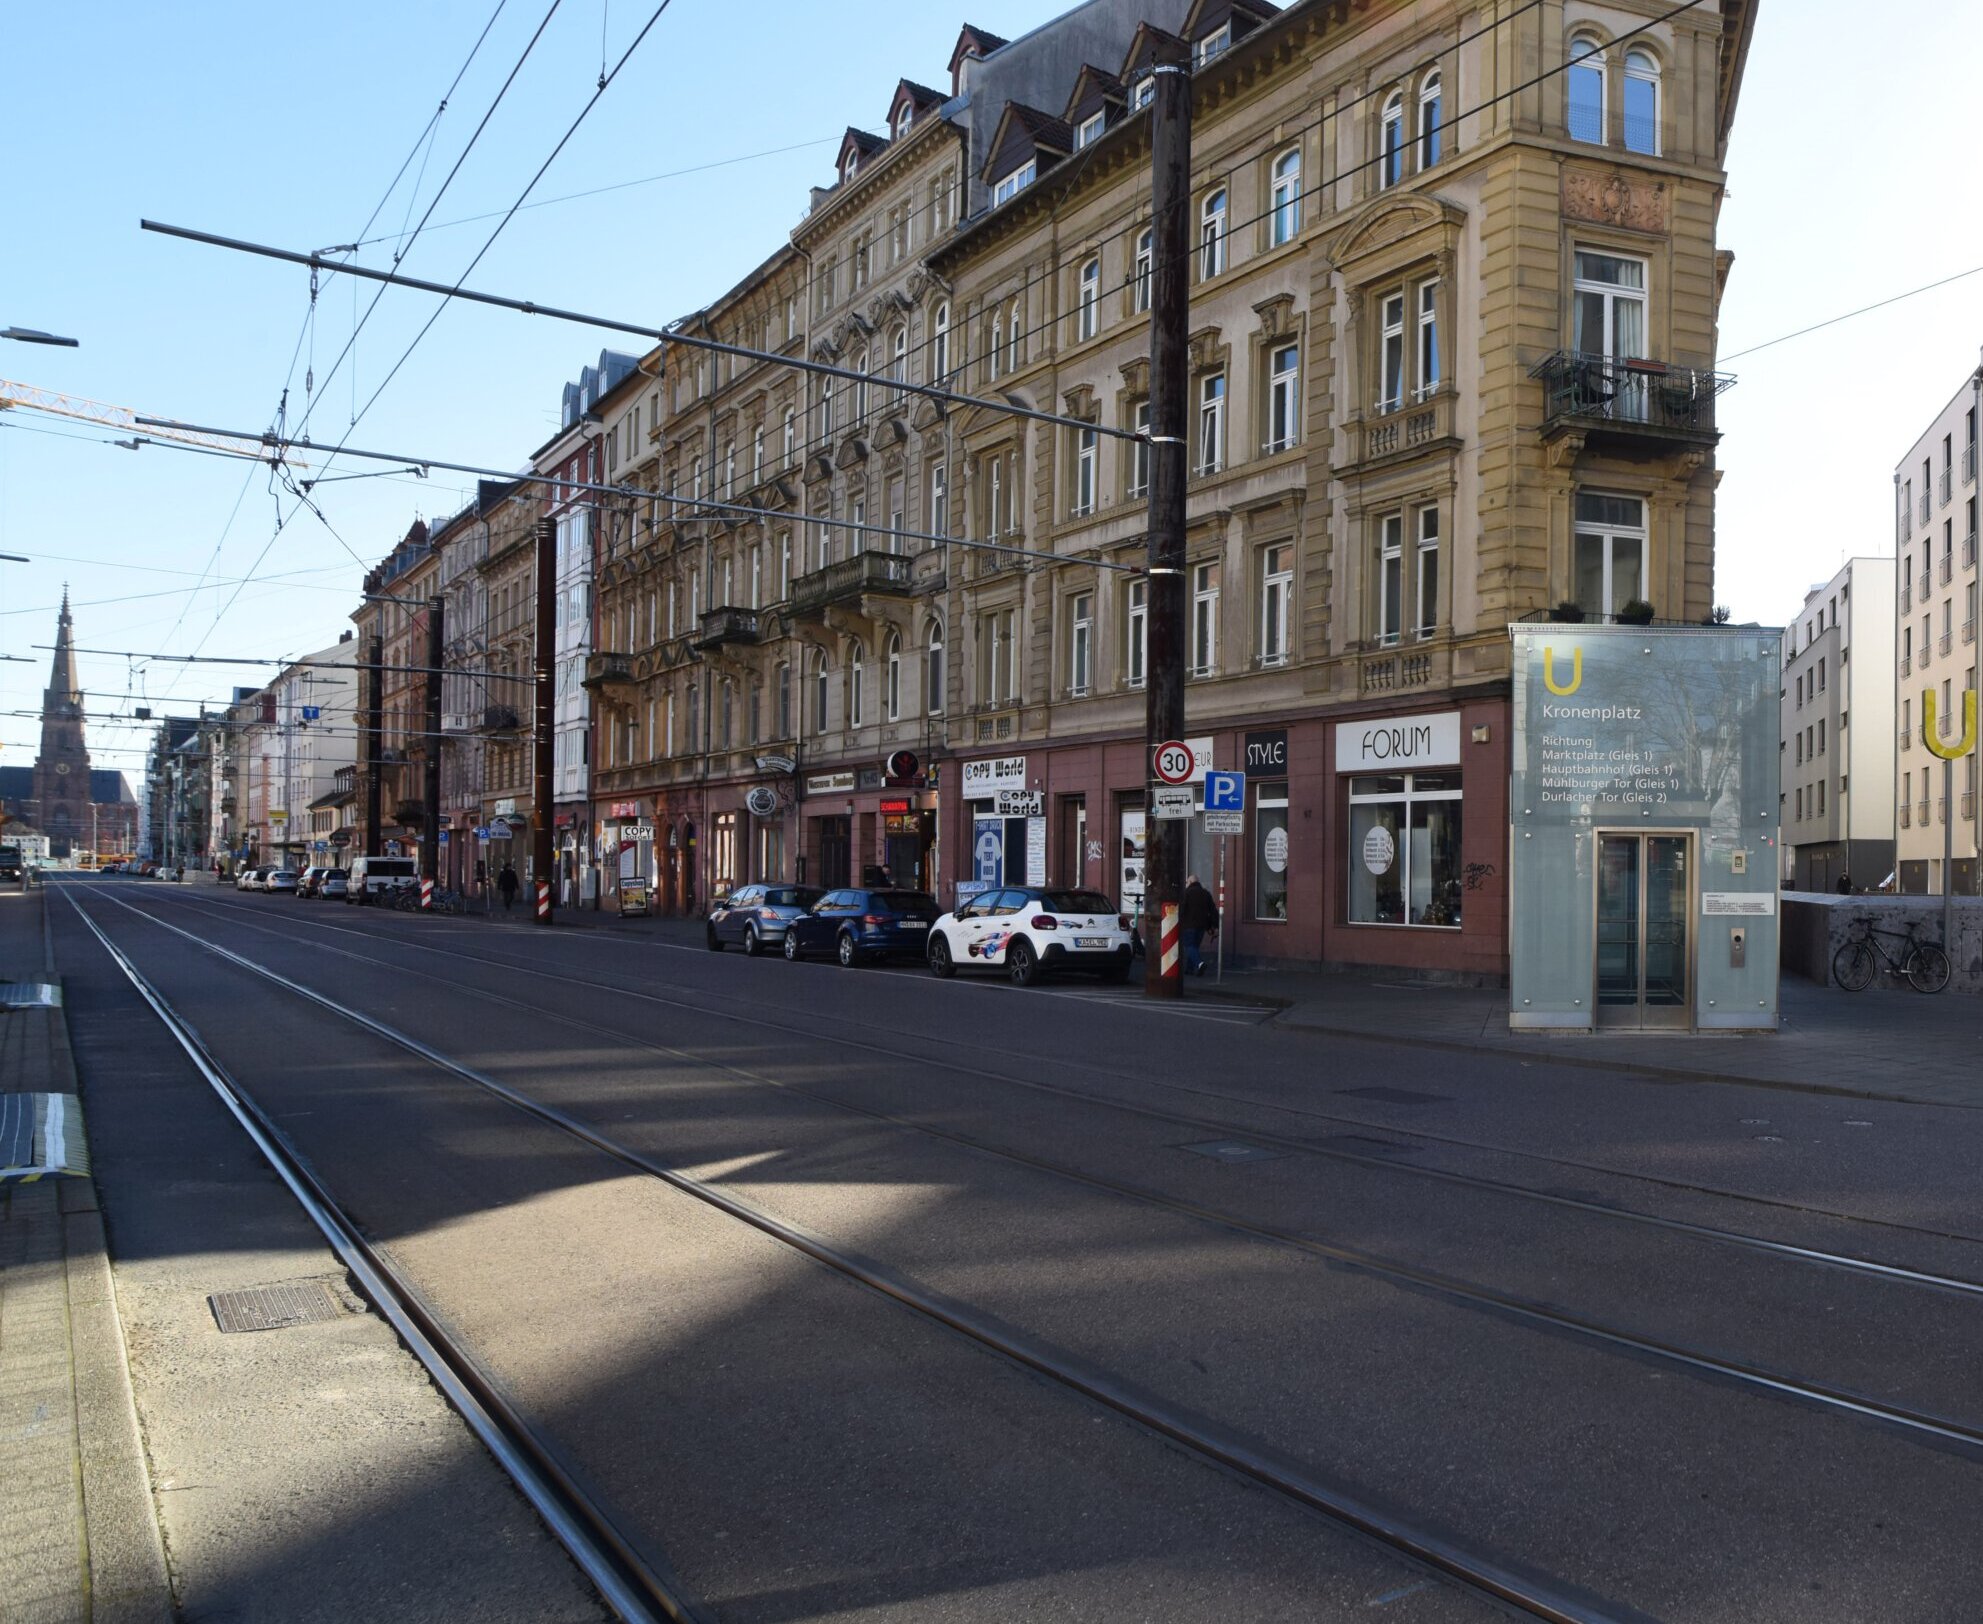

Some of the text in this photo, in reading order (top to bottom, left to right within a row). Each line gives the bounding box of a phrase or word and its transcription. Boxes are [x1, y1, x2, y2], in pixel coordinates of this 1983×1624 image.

[1544, 647, 1582, 696] U
[1543, 704, 1641, 723] Kronenplatz
[1922, 688, 1977, 759] U
[1362, 725, 1431, 760] FORUM
[1542, 735, 1593, 749] Richtung
[1247, 741, 1285, 766] STYLE
[1542, 750, 1653, 763] Marktplatz (Gleis 1)
[965, 758, 1024, 781] Copy World
[1163, 753, 1186, 772] 30
[1542, 763, 1673, 776] Hauptbahnhof (Gleis 1)
[1542, 777, 1680, 790] Mühlburger Tor (Gleis 1)
[1000, 791, 1035, 802] Copy
[1214, 777, 1235, 806] P
[1542, 791, 1668, 804] Durlacher Tor (Gleis 2)
[999, 803, 1039, 814] World
[1168, 807, 1183, 815] frei
[625, 826, 652, 836] COPY
